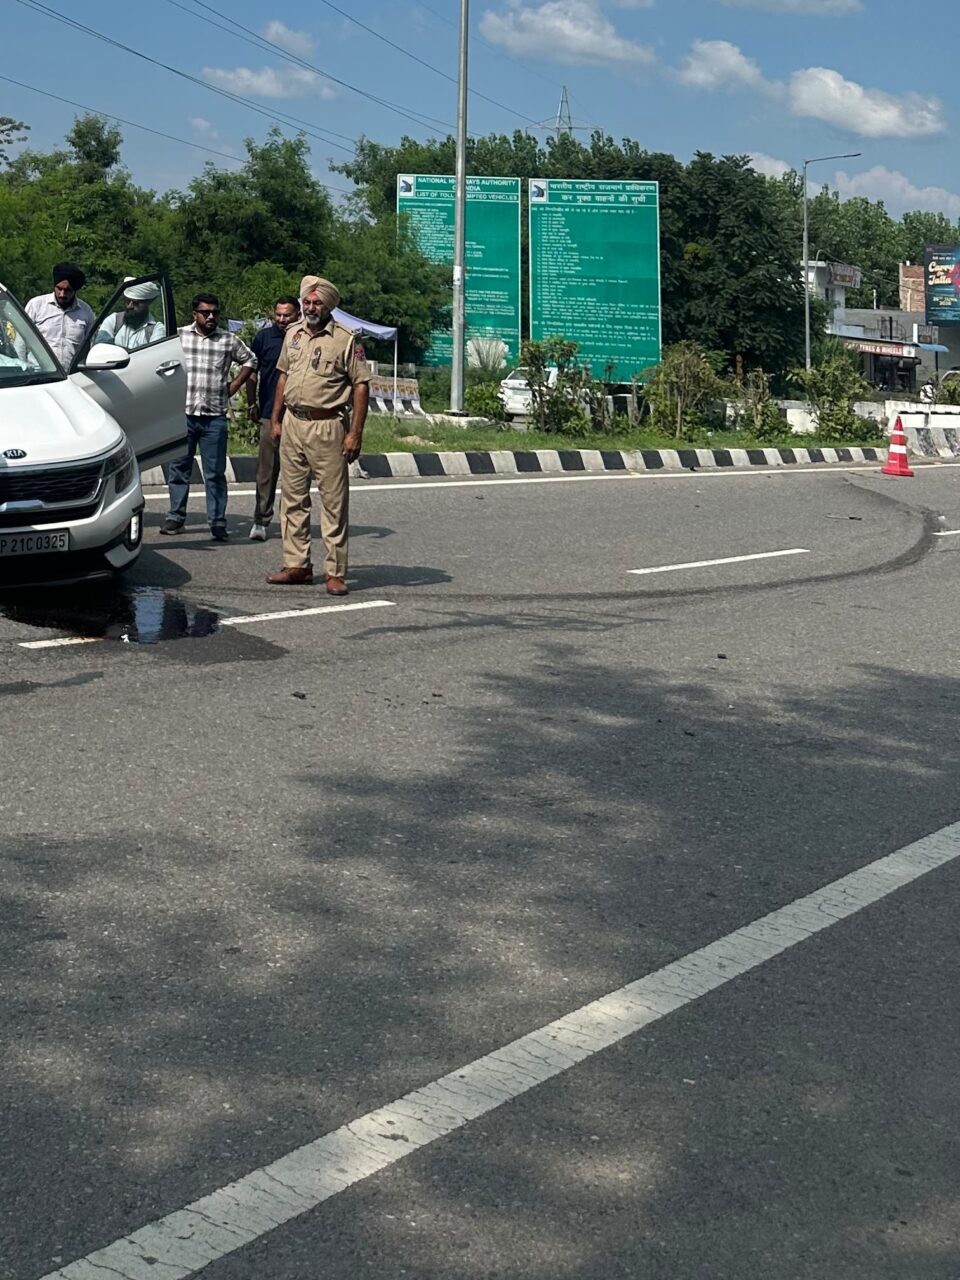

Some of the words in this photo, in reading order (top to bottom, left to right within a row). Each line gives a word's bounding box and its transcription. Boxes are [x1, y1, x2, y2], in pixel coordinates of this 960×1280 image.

[6, 449, 24, 458] KIA
[11, 537, 33, 552] 21C
[36, 535, 65, 550] 0325
